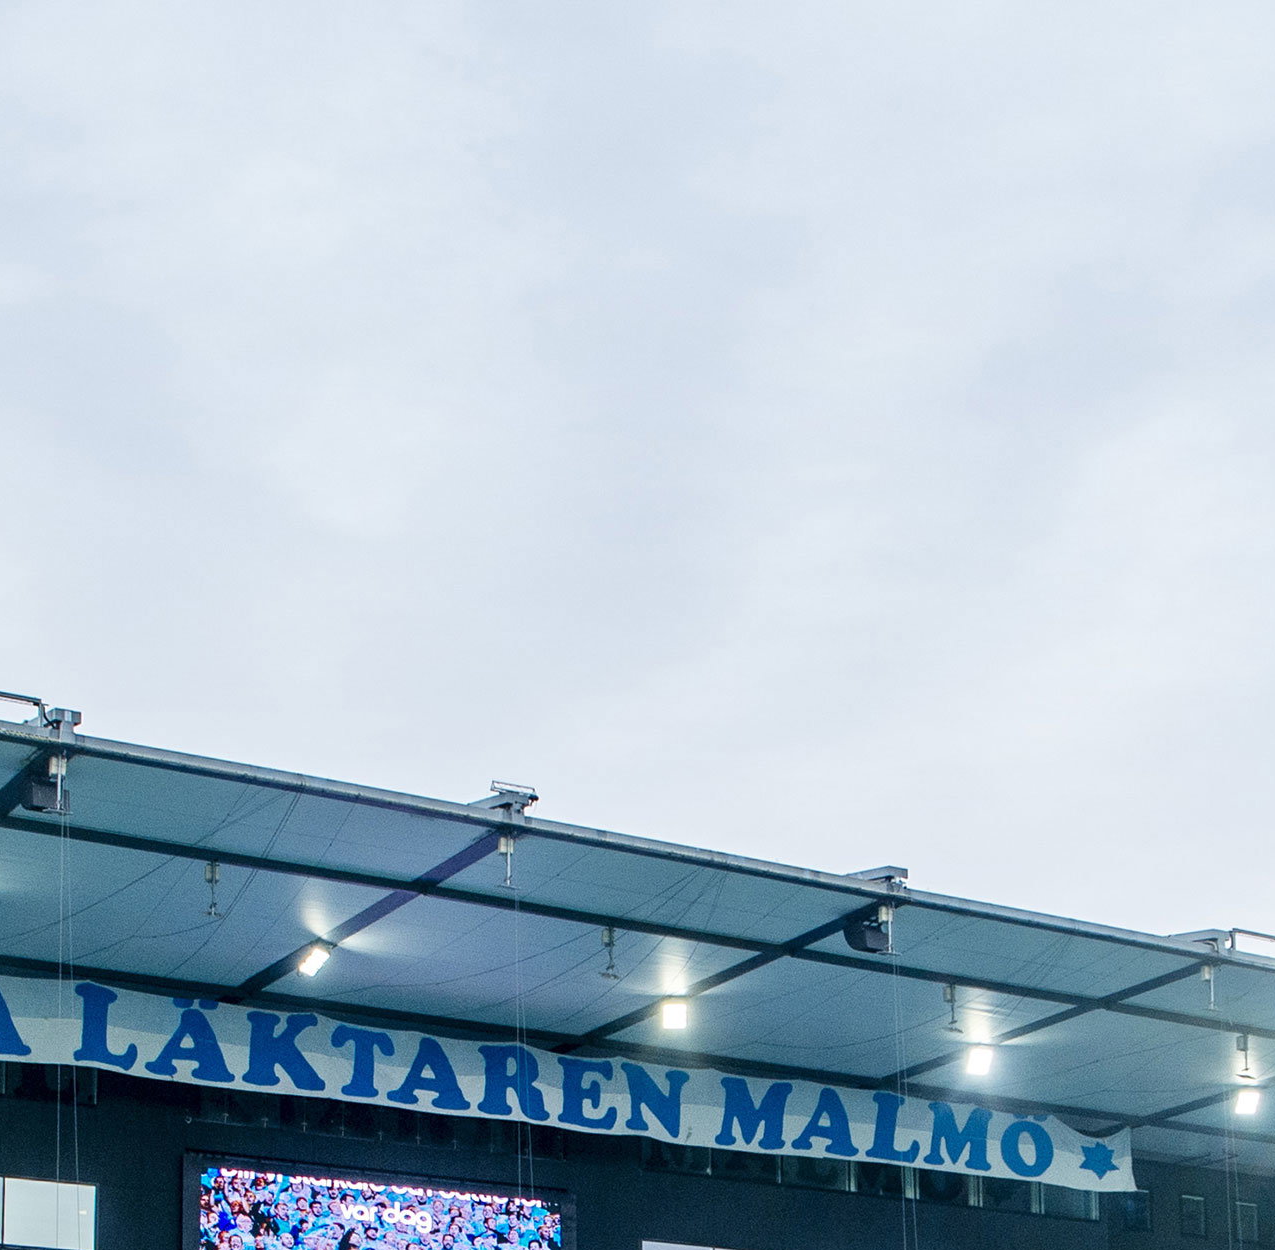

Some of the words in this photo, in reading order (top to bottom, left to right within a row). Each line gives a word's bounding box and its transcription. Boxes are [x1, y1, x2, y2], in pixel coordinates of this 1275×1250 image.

[74, 980, 691, 1133] LÄKTAREN
[715, 1077, 1055, 1178] MALMÖ
[340, 1201, 376, 1222] var
[382, 1202, 432, 1234] dag
